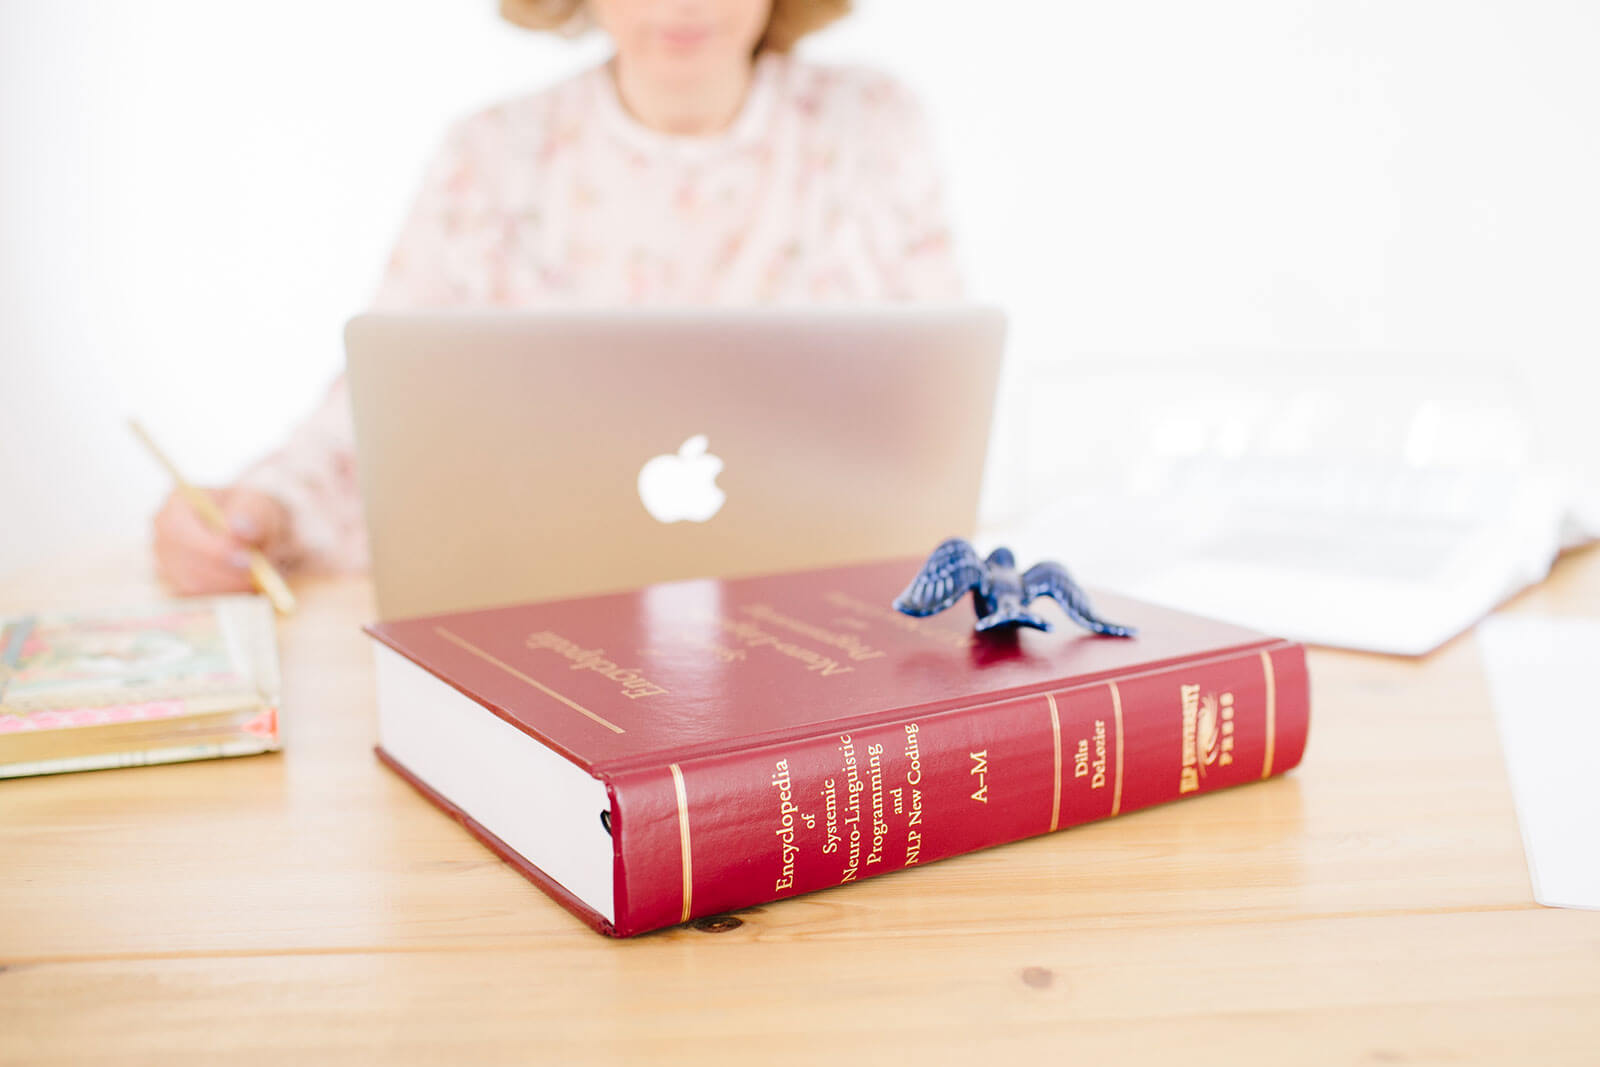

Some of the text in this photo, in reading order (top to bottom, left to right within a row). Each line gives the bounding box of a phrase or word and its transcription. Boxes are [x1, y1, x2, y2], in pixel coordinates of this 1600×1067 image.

[889, 787, 903, 815] and
[904, 722, 922, 866] NLP New Coding
[1091, 719, 1106, 789] DeLozier
[775, 758, 800, 892] Encyclopedia
[801, 812, 816, 829] of
[821, 778, 842, 854] Systemic
[839, 734, 864, 884] Neuro-Linguistic
[866, 743, 888, 865] Programming
